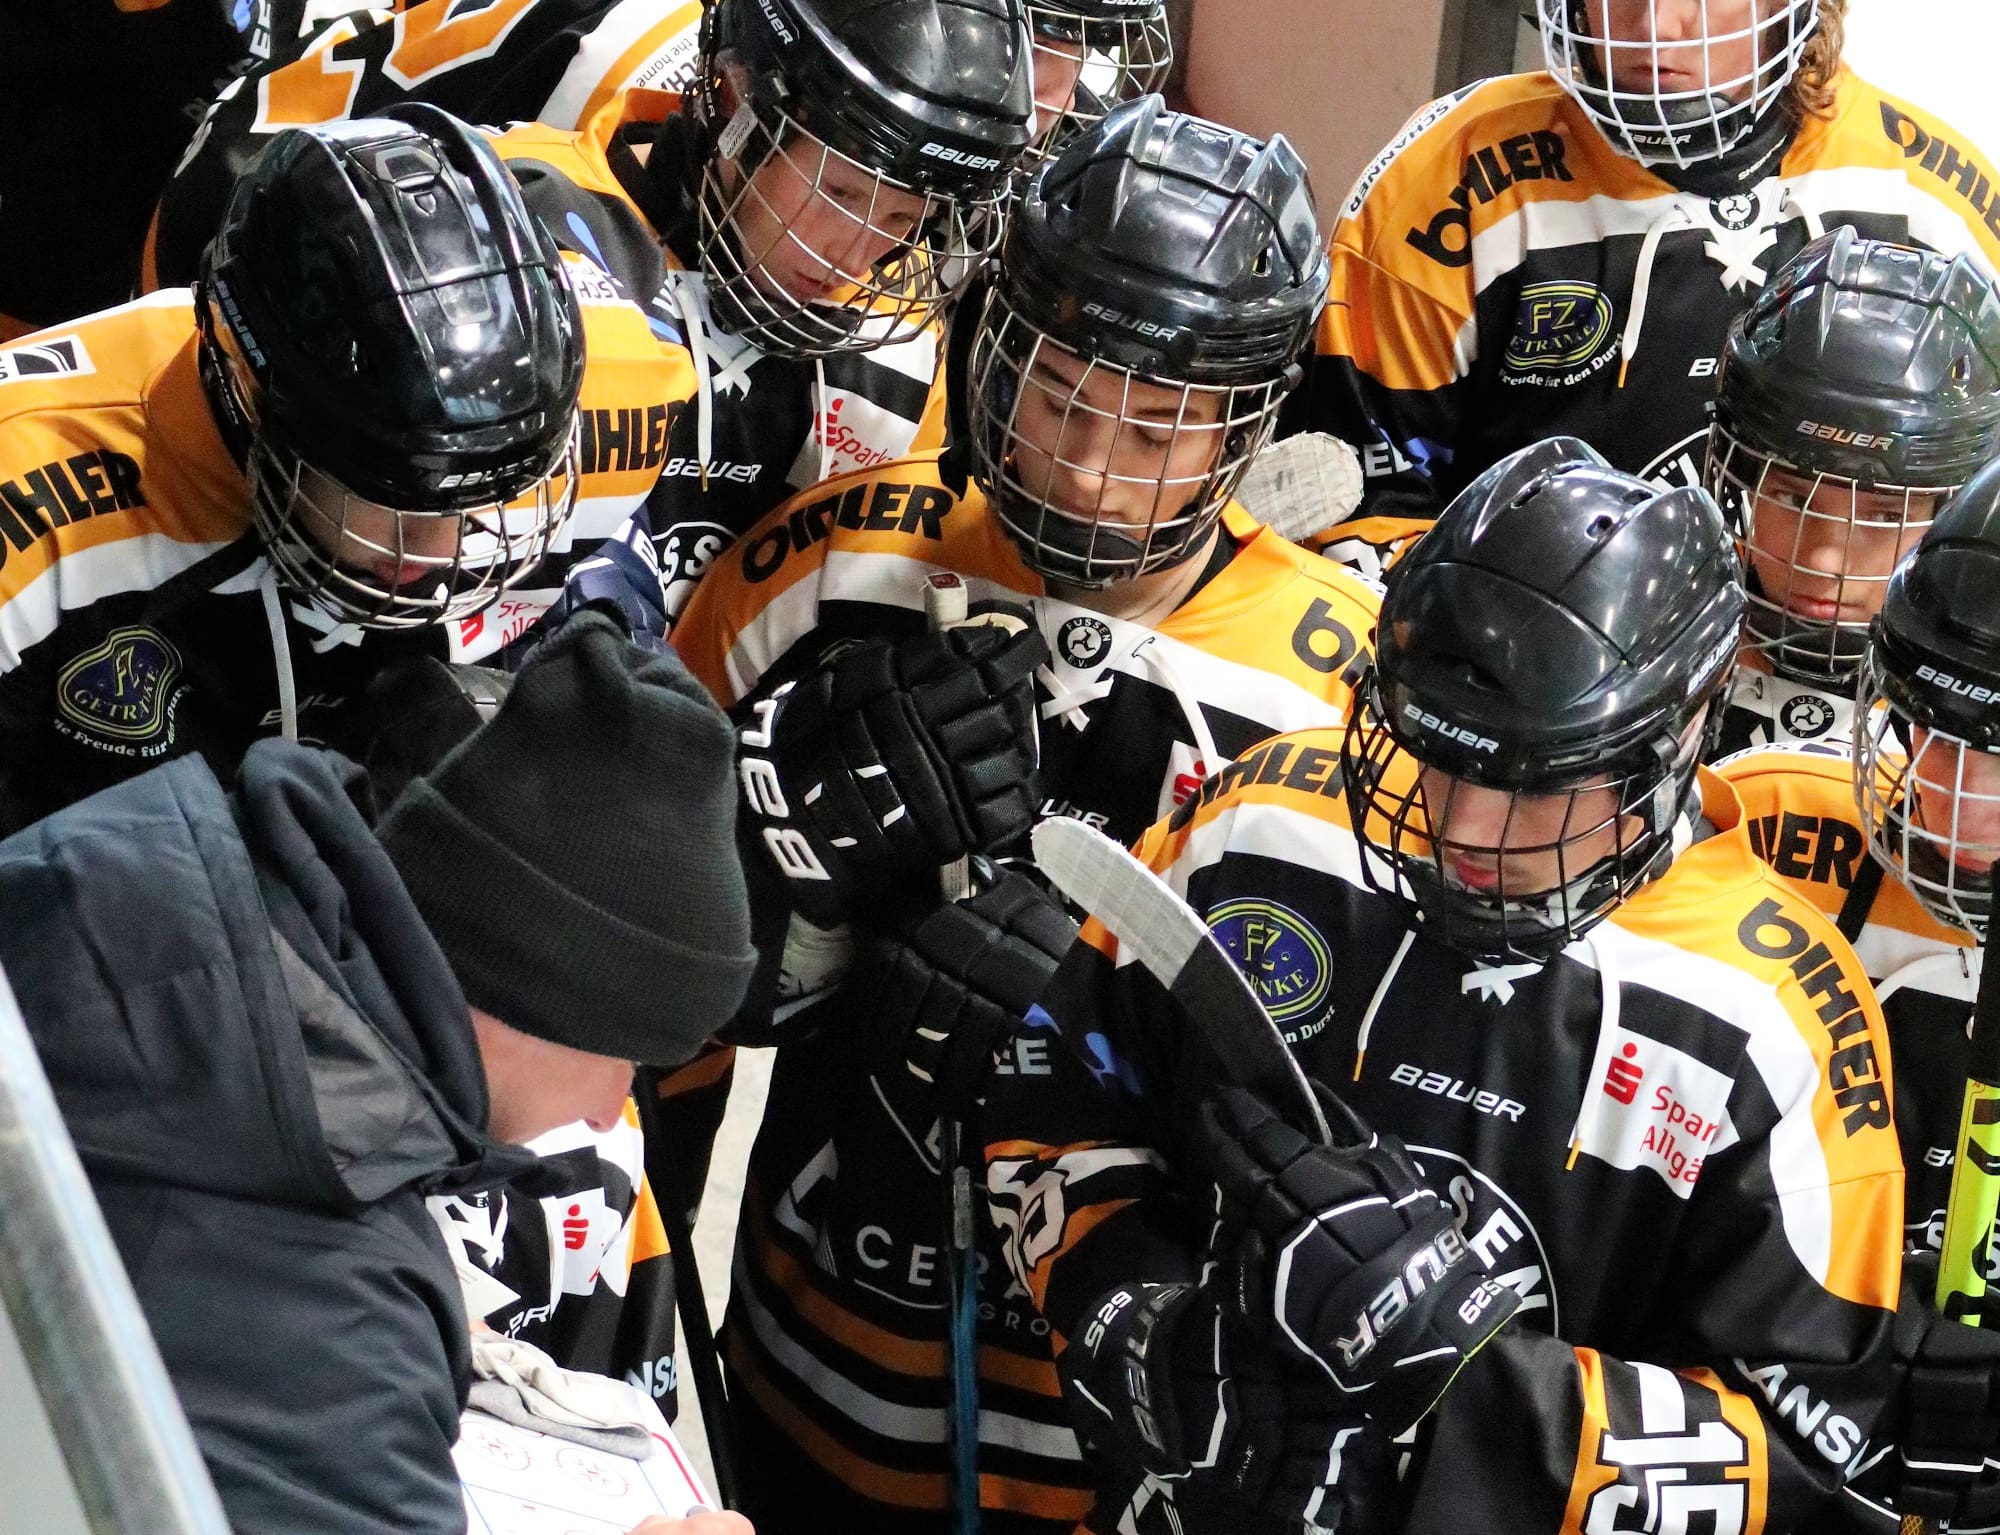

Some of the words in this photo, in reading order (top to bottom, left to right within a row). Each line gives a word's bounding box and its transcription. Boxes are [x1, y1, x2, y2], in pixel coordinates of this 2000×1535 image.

[919, 142, 1001, 172] BAUER
[1795, 419, 1894, 451] BAUER
[660, 457, 763, 484] BAUER
[73, 731, 137, 757] Freude
[1403, 703, 1500, 754] BAUER
[1389, 1063, 1528, 1123] BAUER
[1084, 1290, 1133, 1359] S29
